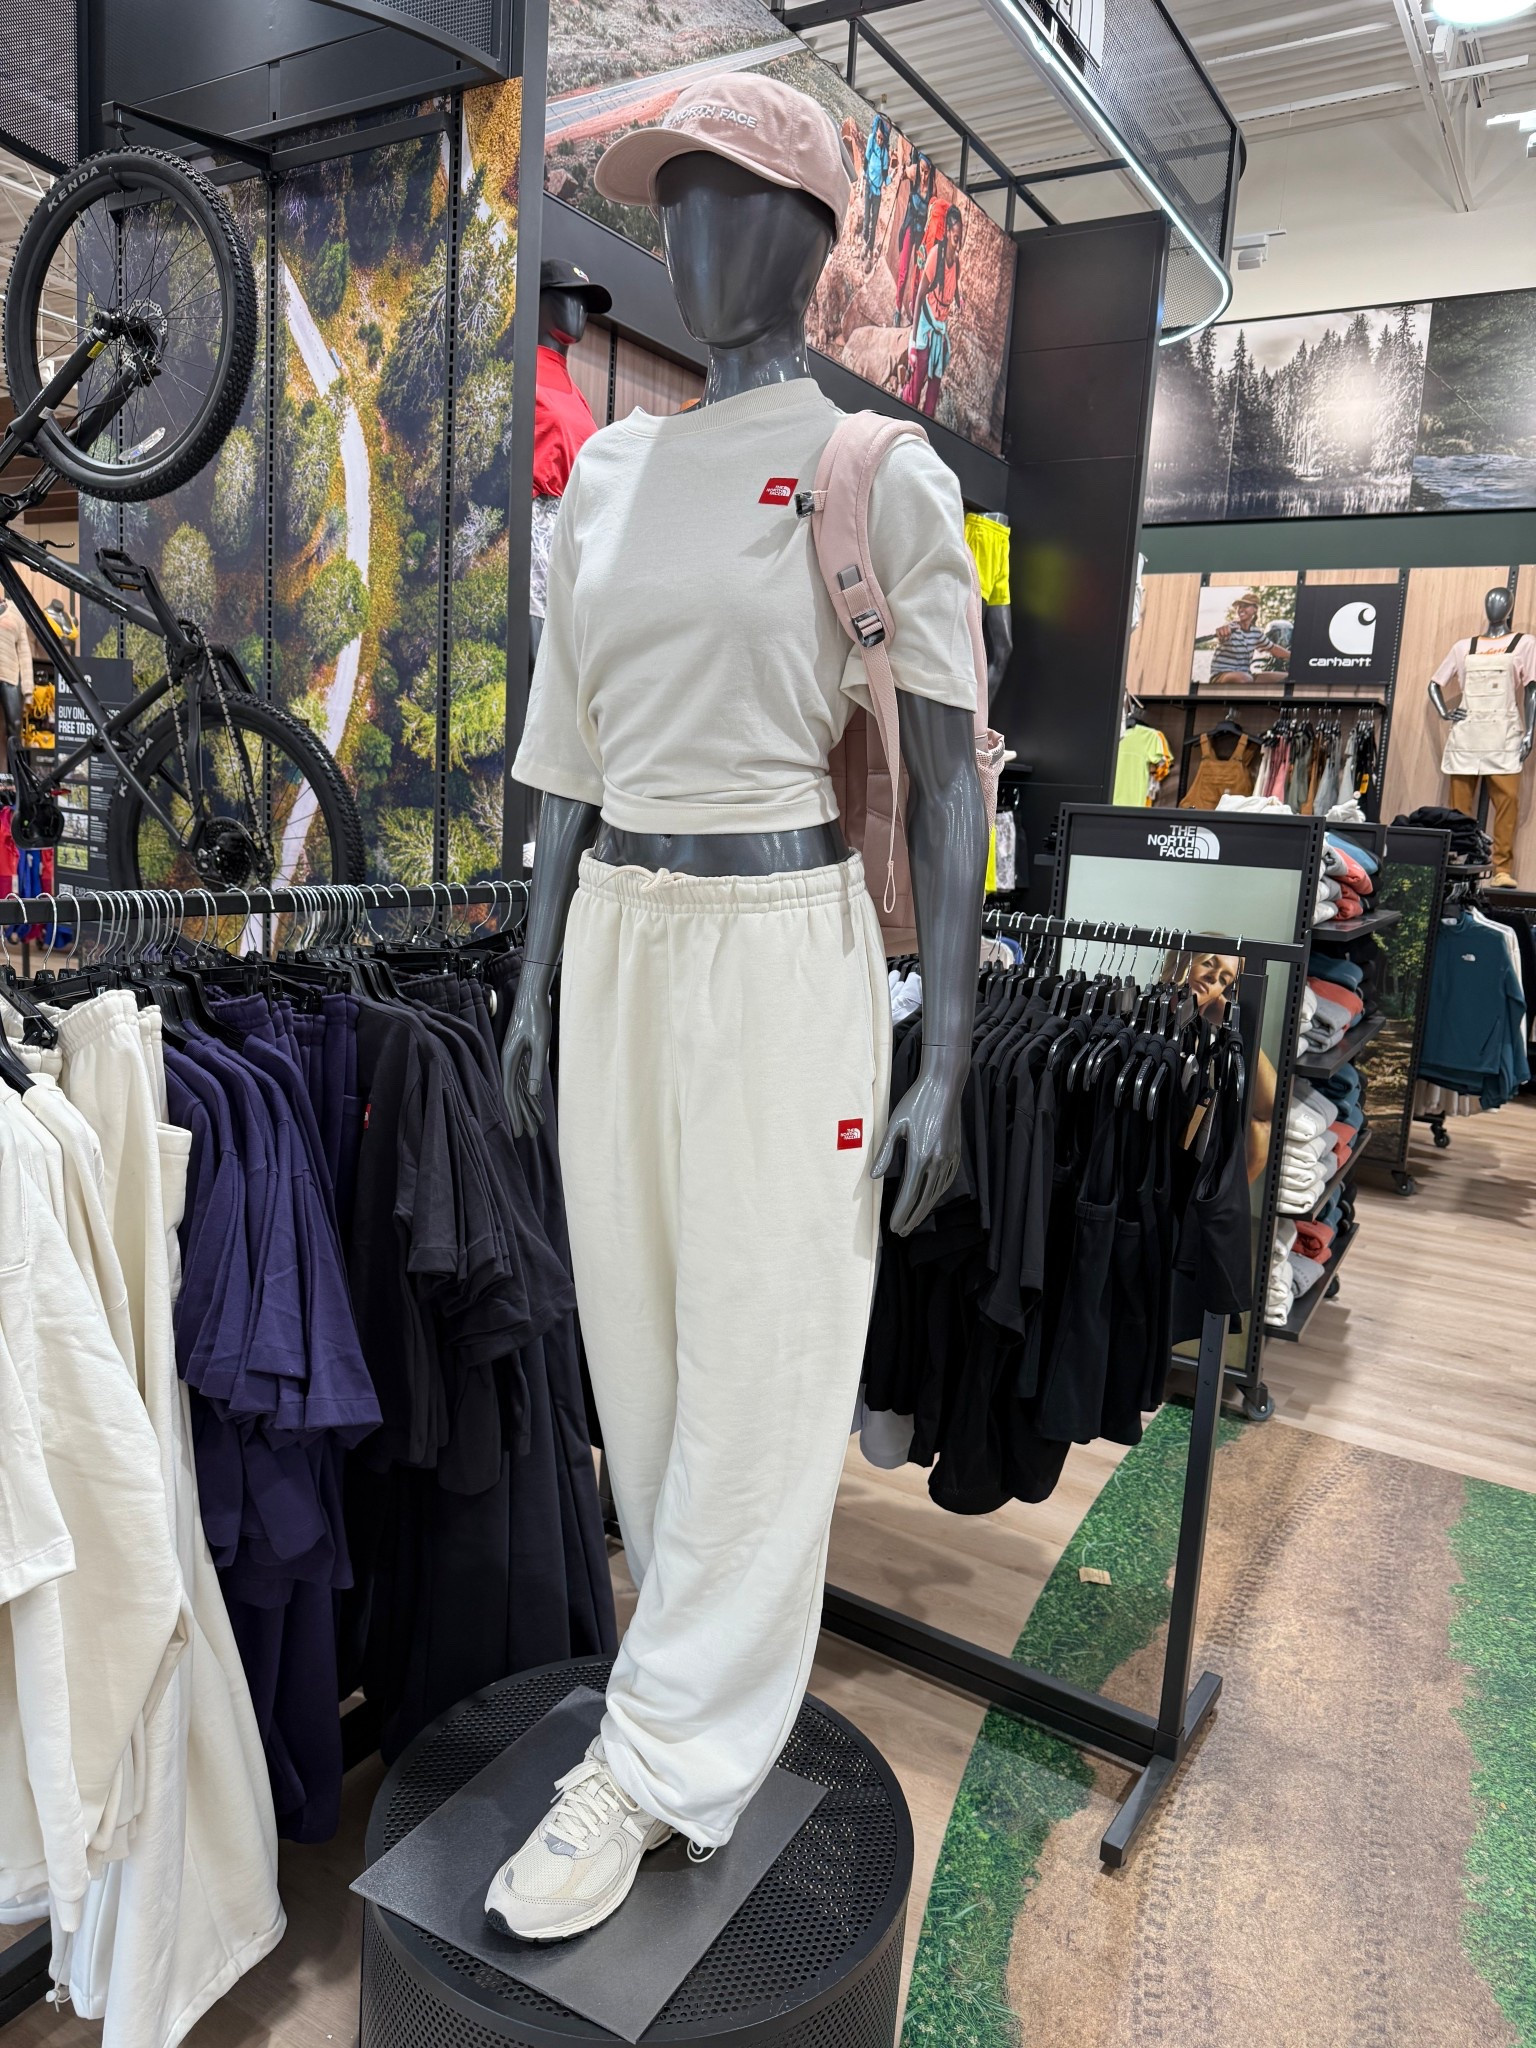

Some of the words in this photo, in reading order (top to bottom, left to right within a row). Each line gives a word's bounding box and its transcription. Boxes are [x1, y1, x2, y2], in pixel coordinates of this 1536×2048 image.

[719, 108, 758, 129] FACE
[47, 166, 100, 213] KENDA
[1308, 656, 1372, 667] carhartt
[58, 706, 72, 719] BUY
[58, 720, 75, 734] FREE
[76, 722, 85, 735] TO
[118, 737, 155, 798] KNDA
[1170, 825, 1197, 837] THE
[1147, 834, 1196, 848] NORTH
[1159, 846, 1194, 858] FACE
